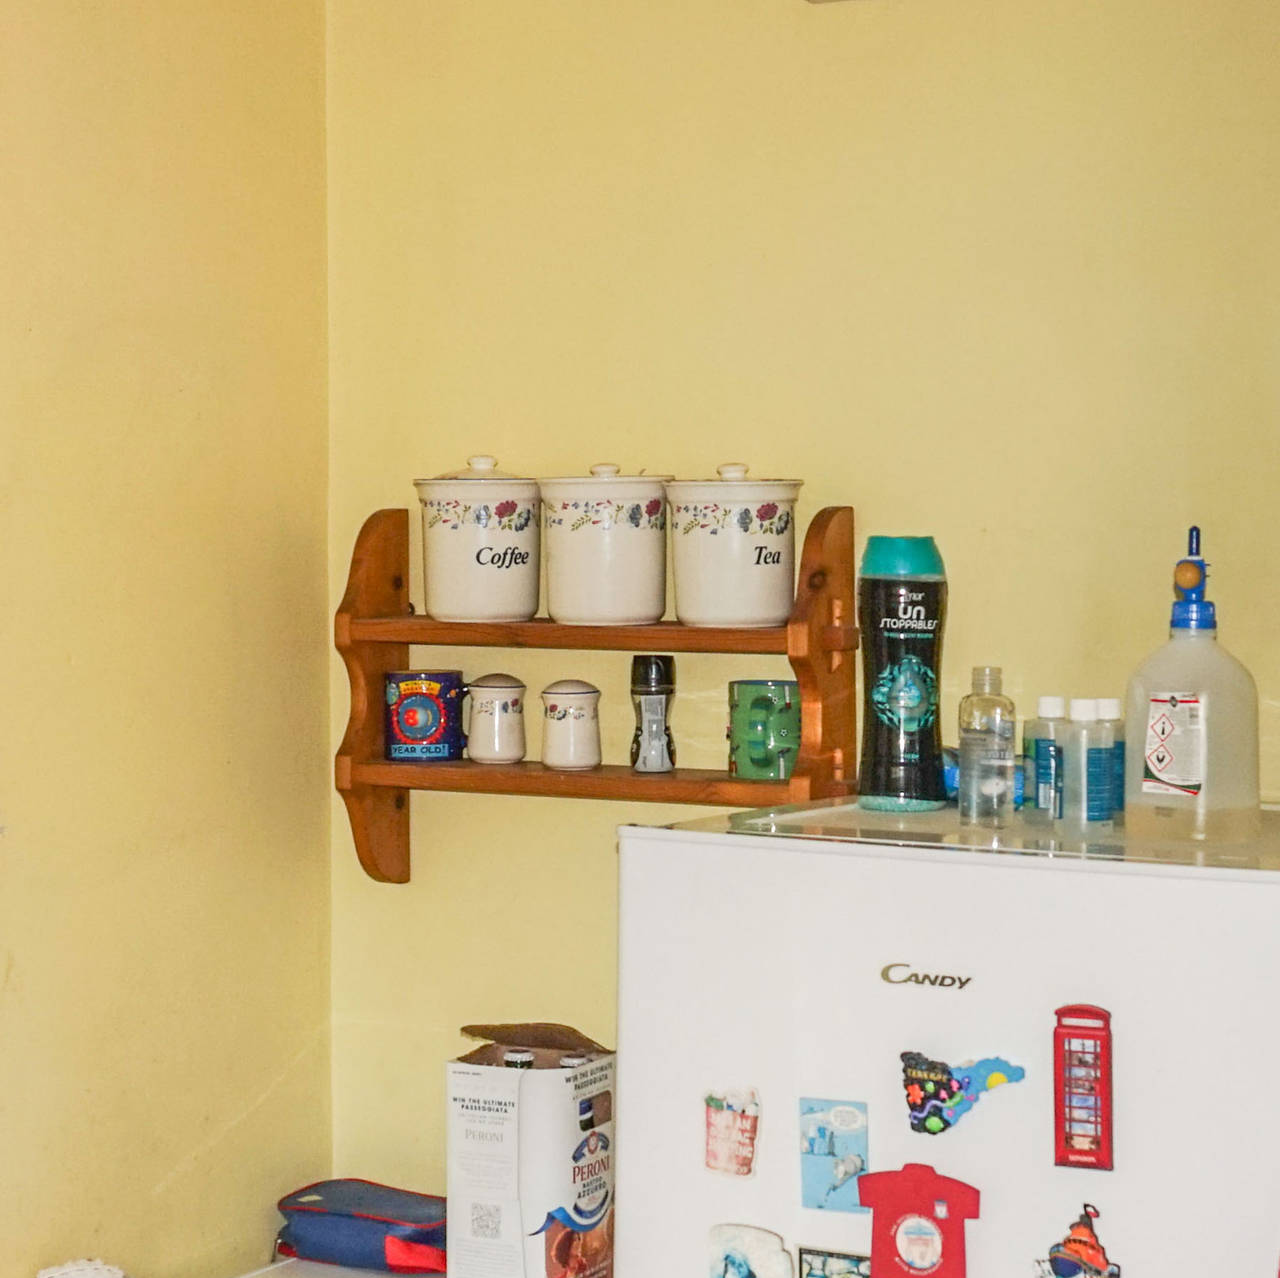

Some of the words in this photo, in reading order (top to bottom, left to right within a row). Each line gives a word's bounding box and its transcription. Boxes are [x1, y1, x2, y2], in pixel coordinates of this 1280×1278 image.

[475, 546, 529, 569] Coffee
[754, 545, 781, 565] Tea
[880, 618, 938, 630] STOPPABLES
[881, 963, 972, 989] CANDY
[572, 1154, 610, 1184] PERONI
